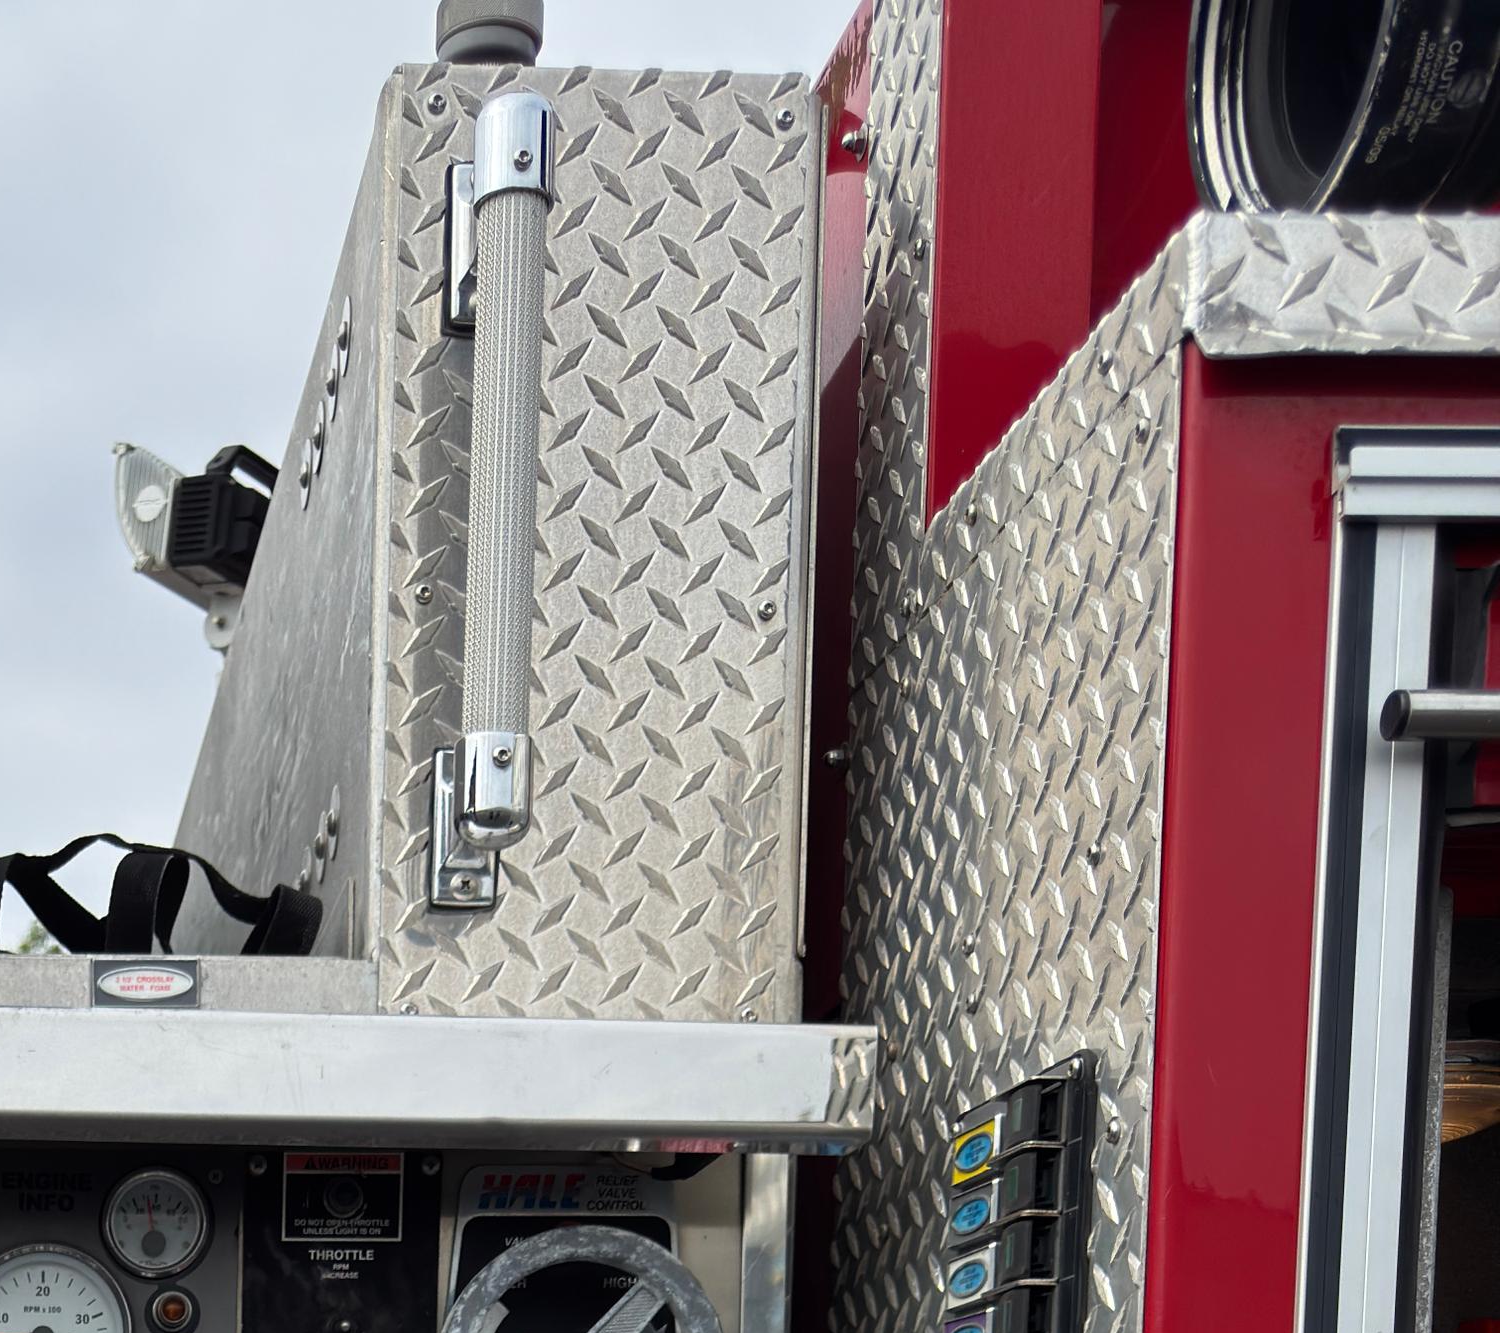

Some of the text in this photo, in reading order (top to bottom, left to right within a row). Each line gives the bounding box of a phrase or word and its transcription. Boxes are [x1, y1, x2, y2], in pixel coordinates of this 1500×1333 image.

[1425, 40, 1463, 124] CAUTION
[318, 1158, 389, 1169] WARNING
[596, 1176, 639, 1185] RELIEF
[479, 1175, 586, 1209] HALE
[598, 1189, 636, 1198] VALVE
[587, 1201, 645, 1211] CONTROL
[308, 1249, 375, 1261] THROTTLE
[36, 1286, 50, 1297] 20
[76, 1314, 89, 1324] 30
